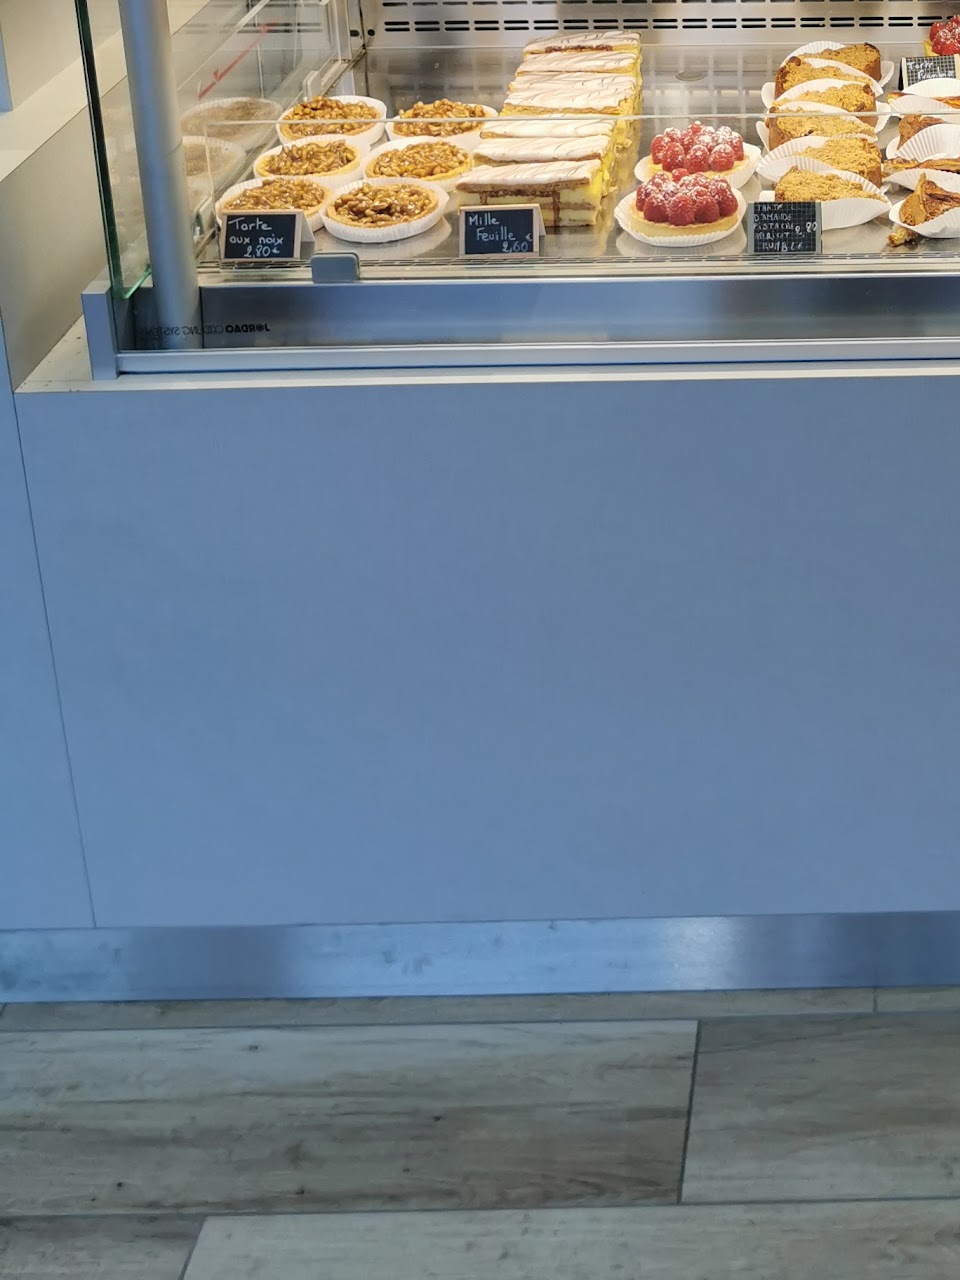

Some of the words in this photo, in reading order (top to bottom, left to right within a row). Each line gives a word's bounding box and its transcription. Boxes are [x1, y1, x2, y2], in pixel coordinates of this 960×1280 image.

[227, 216, 273, 231] Tarte
[468, 212, 500, 226] Mille
[229, 236, 251, 245] aux
[258, 233, 284, 246] noix
[476, 225, 517, 242] Feuille
[502, 241, 529, 253] 2,60
